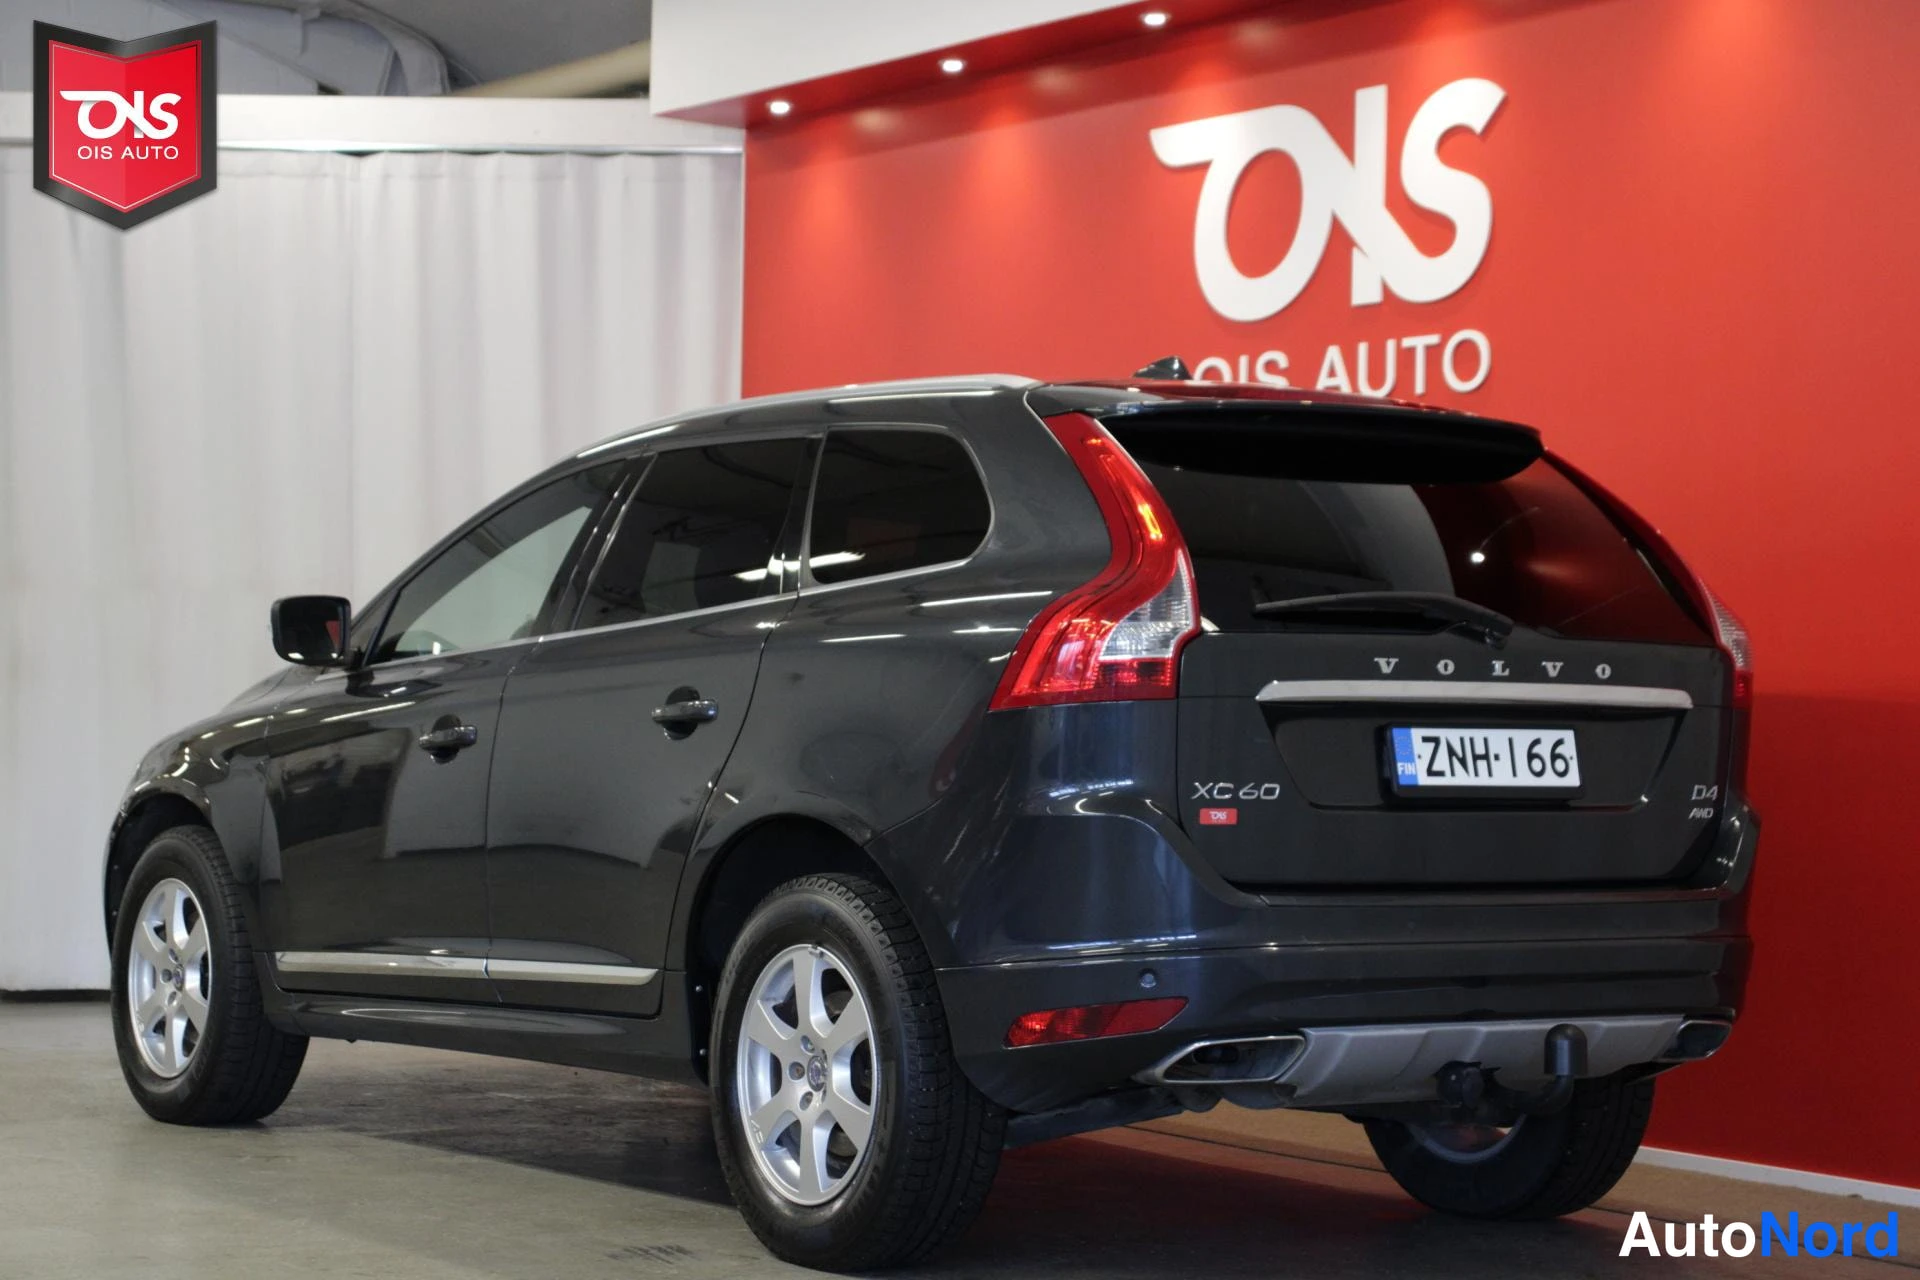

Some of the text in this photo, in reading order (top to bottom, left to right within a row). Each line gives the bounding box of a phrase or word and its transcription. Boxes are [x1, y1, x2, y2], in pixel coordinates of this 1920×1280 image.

[1315, 329, 1491, 398] AUTO
[1374, 657, 1612, 679] VOLVO
[1421, 736, 1570, 778] ZNH-166
[1397, 762, 1416, 776] FIN
[1691, 784, 1718, 801] D4
[1688, 807, 1714, 819] AWD
